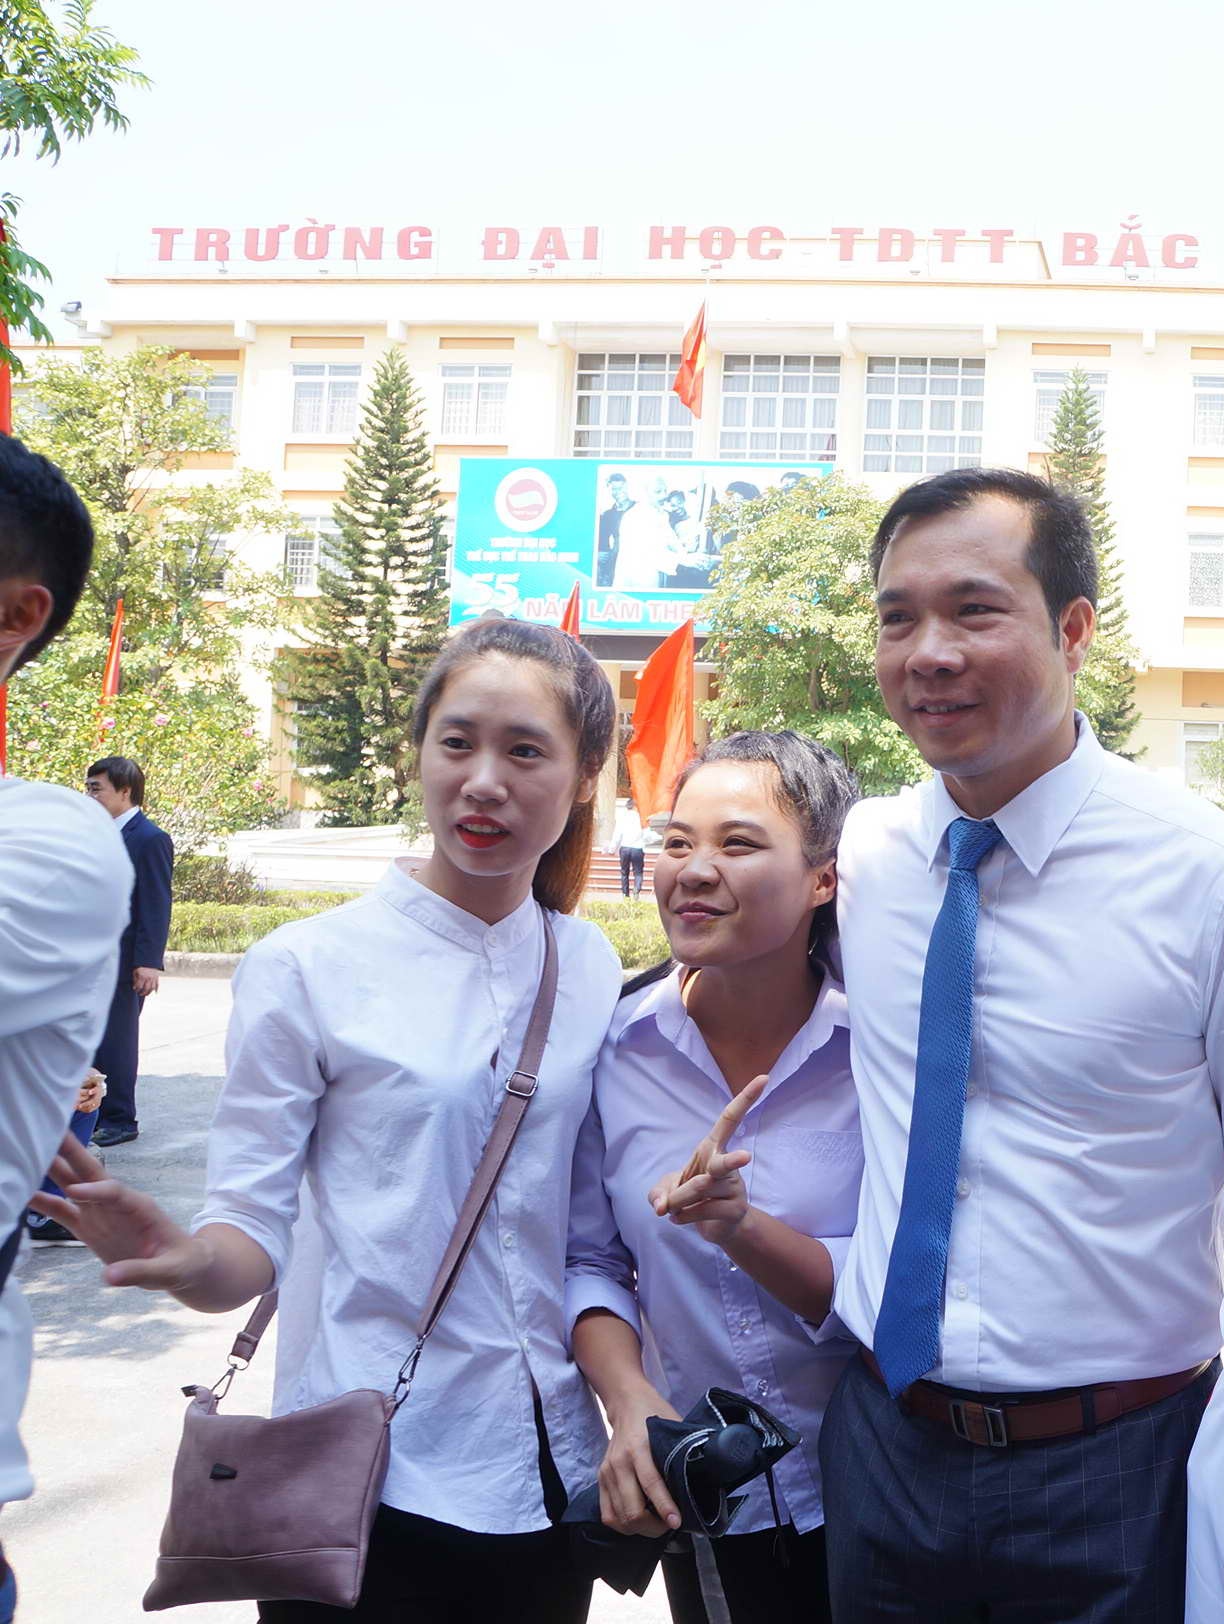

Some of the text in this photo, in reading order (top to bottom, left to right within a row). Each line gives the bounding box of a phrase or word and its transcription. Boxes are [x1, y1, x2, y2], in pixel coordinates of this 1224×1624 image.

[151, 217, 433, 262] TRƯỜNG
[481, 226, 600, 269] ĐẠI
[648, 225, 786, 270] HỌC
[831, 227, 1014, 263] TDTT
[1061, 214, 1199, 269] BẮC
[464, 573, 520, 608] 55
